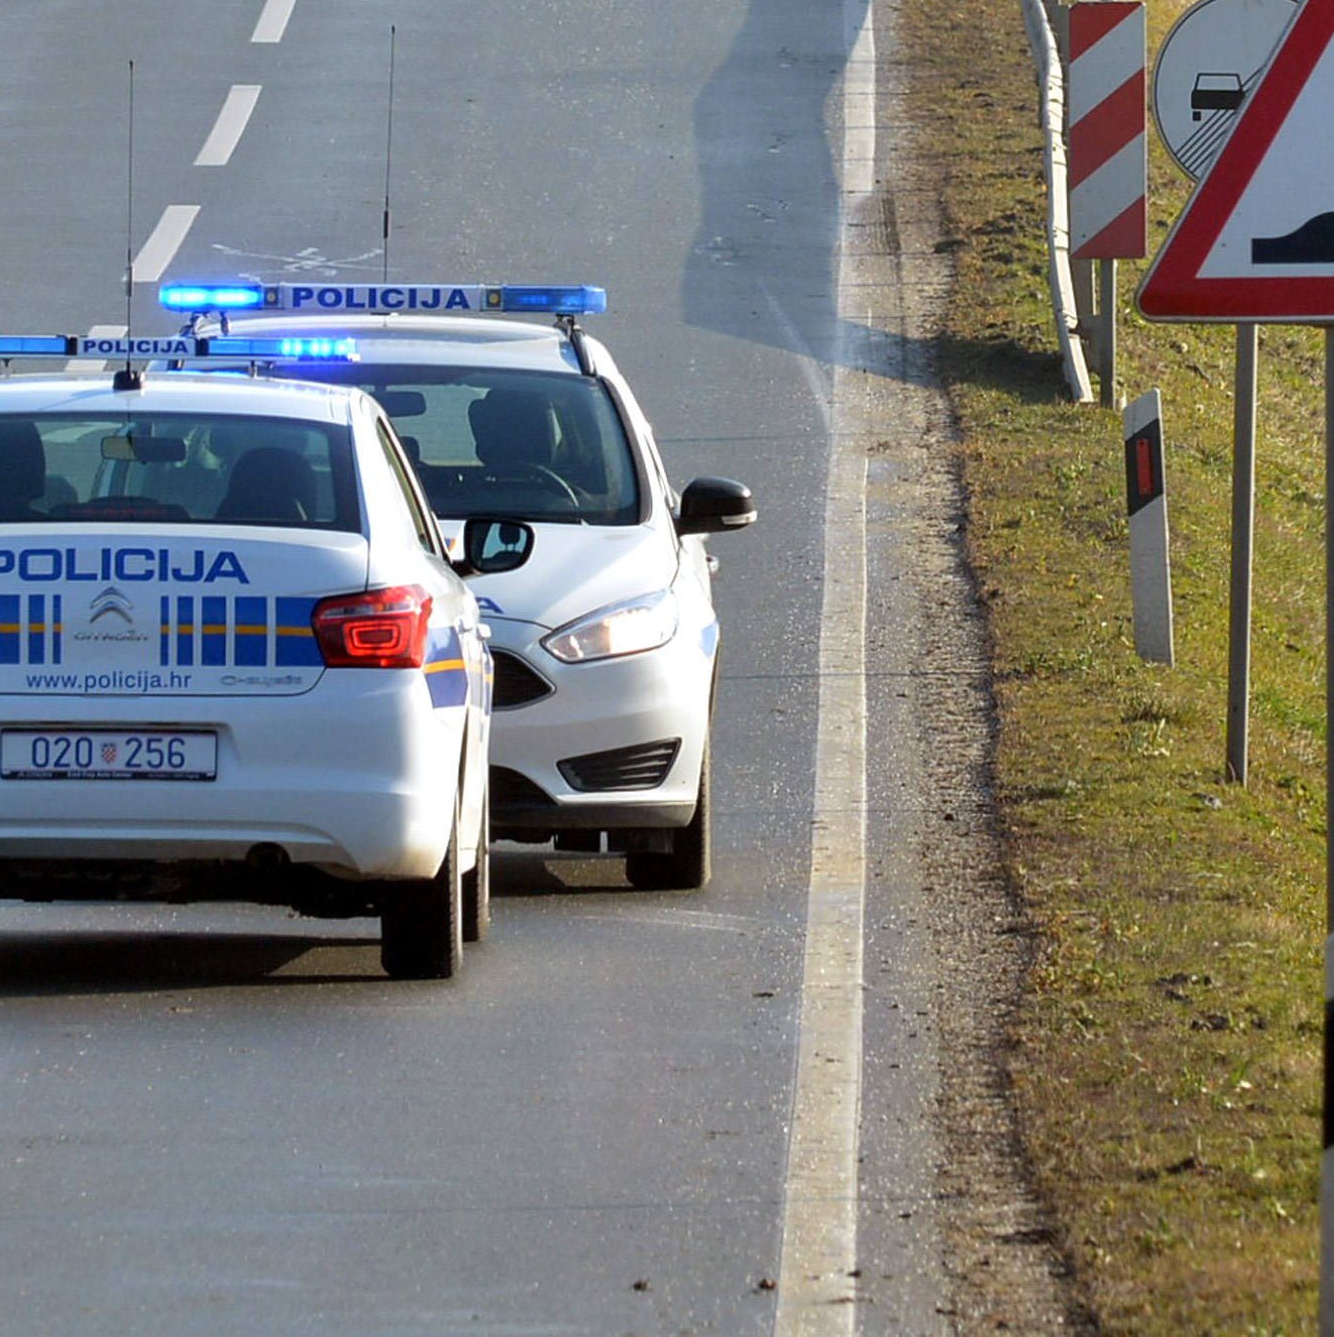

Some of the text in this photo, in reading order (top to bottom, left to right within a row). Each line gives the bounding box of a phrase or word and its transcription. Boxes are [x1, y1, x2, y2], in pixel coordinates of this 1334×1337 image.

[291, 287, 471, 310] POLICIJA
[82, 339, 189, 354] POLICIJA
[26, 671, 192, 692] www.policija.hr
[32, 737, 186, 769] 020 256
